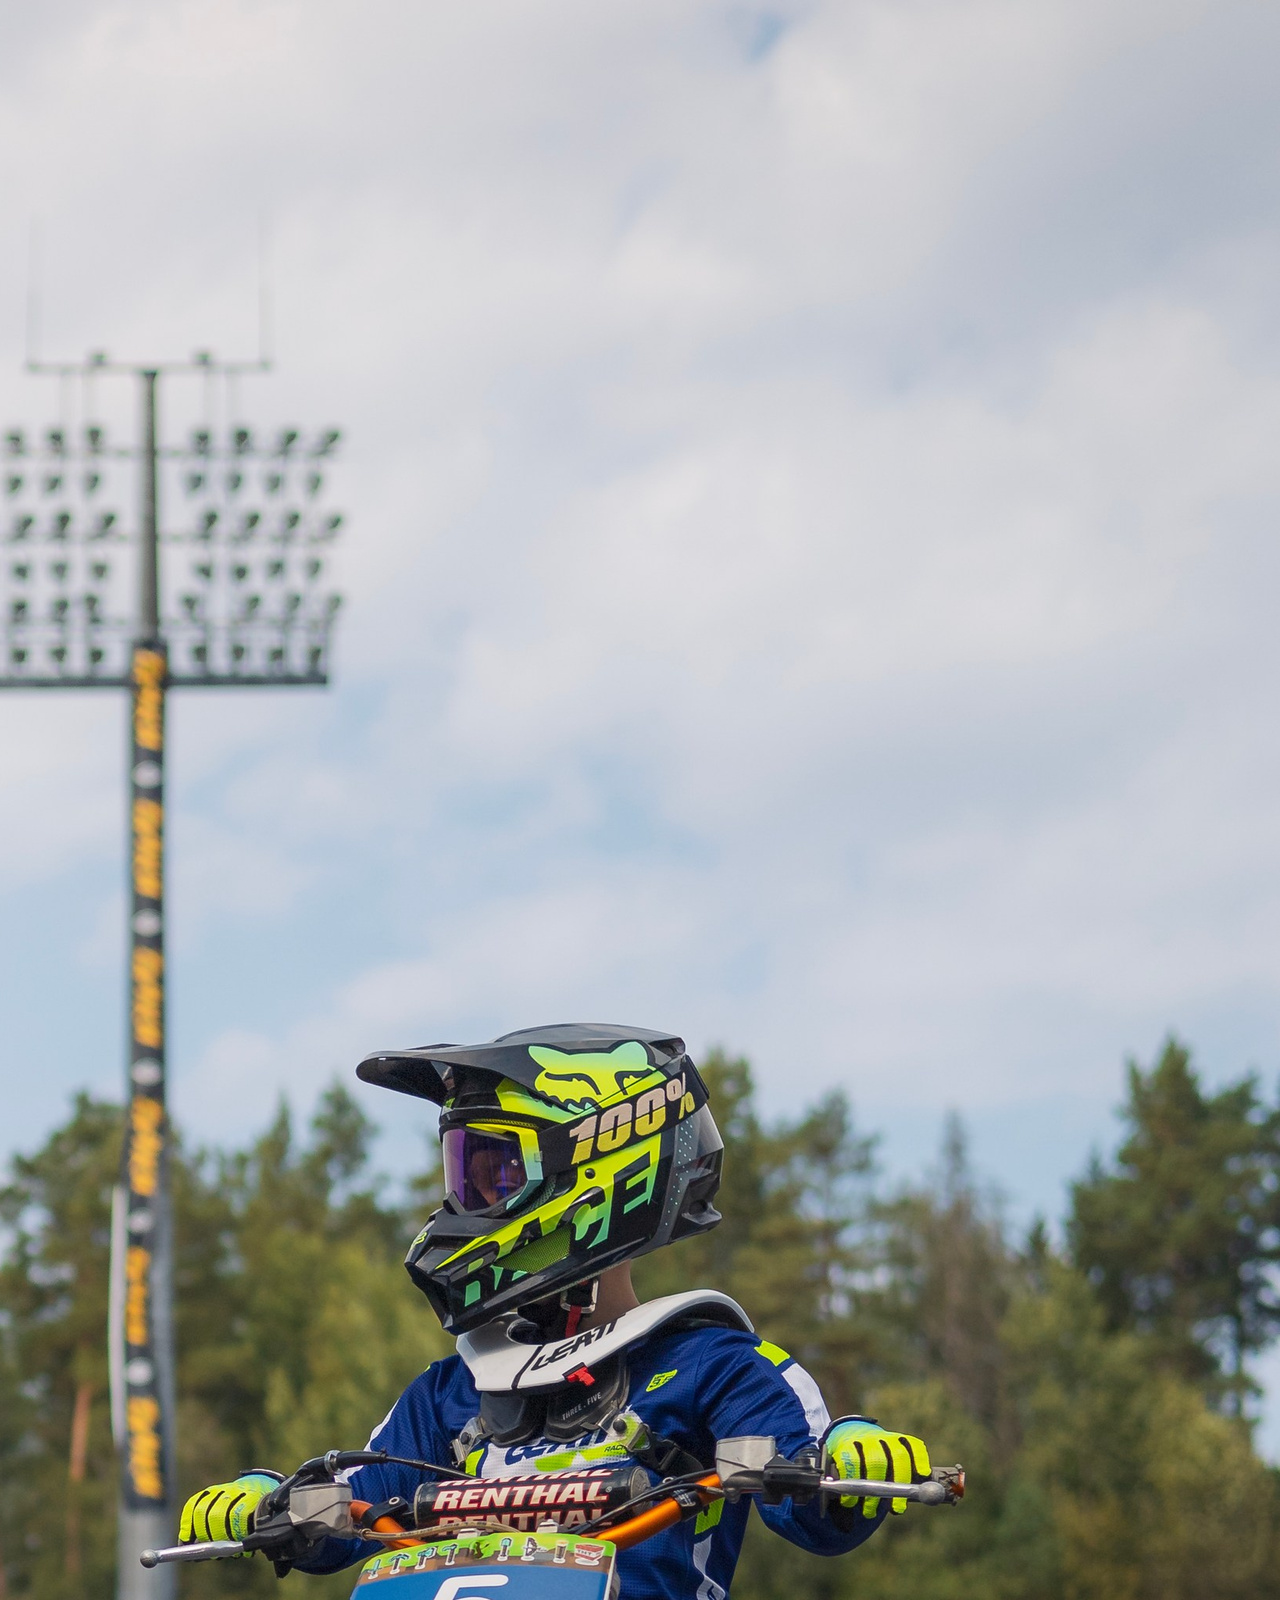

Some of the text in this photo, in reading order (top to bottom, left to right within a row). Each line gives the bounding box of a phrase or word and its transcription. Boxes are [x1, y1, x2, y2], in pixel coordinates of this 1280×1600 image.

[569, 1072, 696, 1166] 100%
[561, 1392, 602, 1420] THREE FIVE
[433, 1481, 609, 1511] RENTHAL
